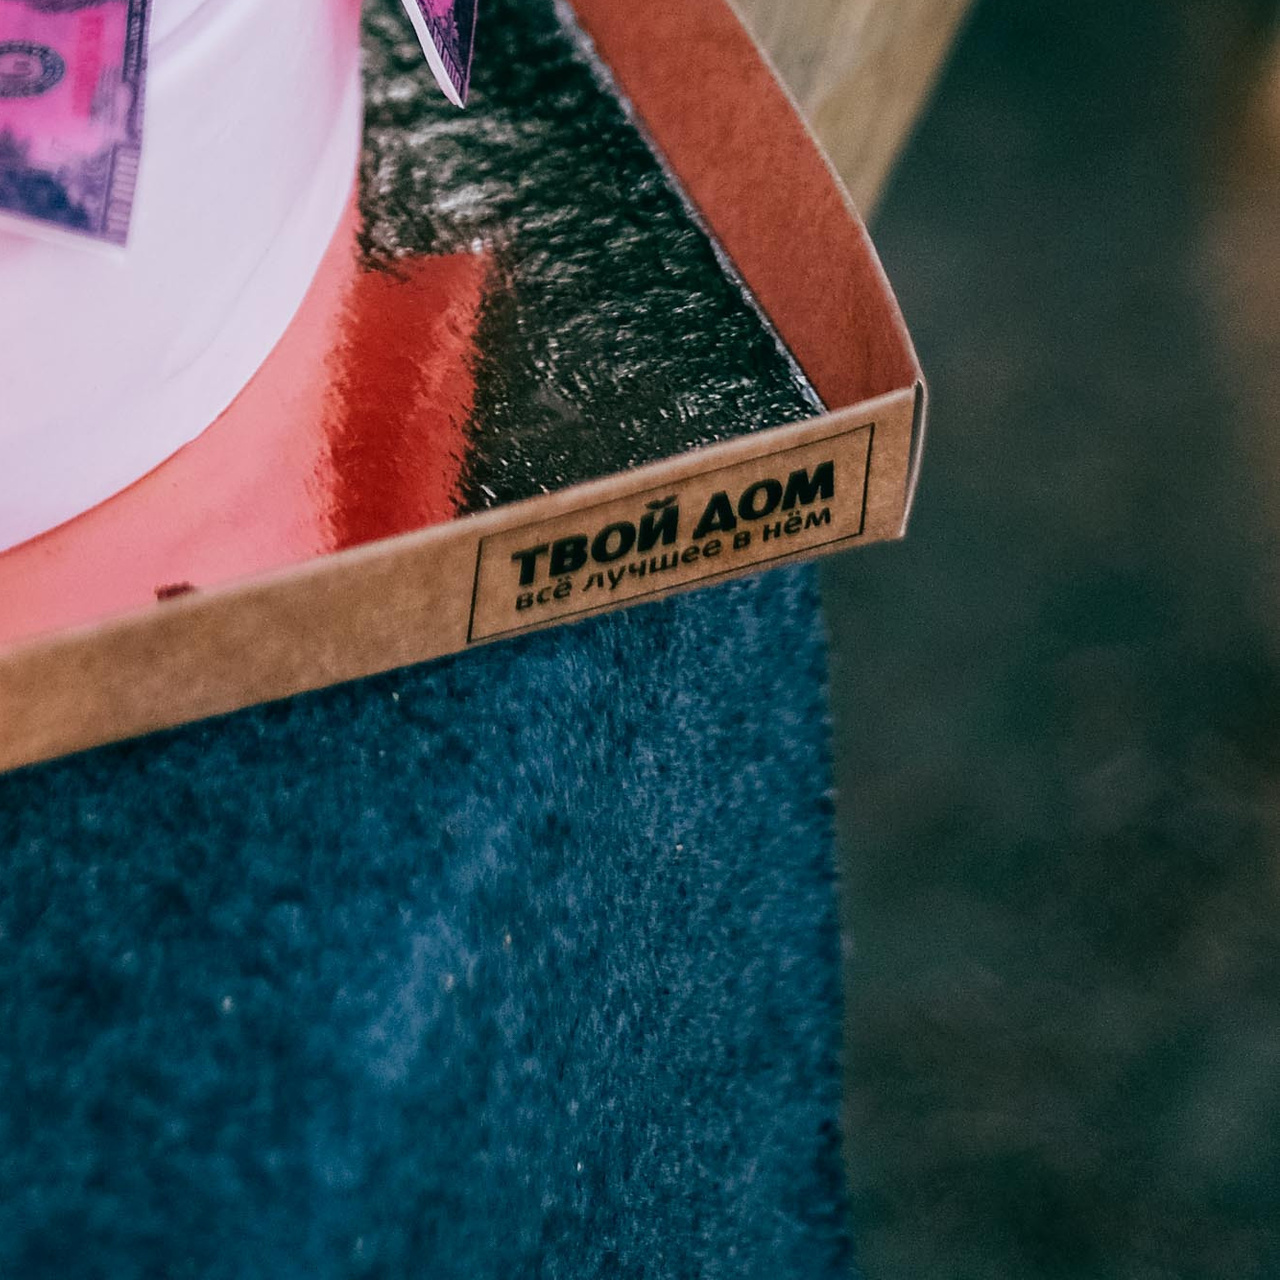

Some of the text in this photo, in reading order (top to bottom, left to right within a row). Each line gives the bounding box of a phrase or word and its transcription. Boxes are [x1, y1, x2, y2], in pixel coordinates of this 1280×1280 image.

[511, 460, 836, 587] ТВОЙ ДОМ
[515, 505, 832, 612] всё лучшее в нём
